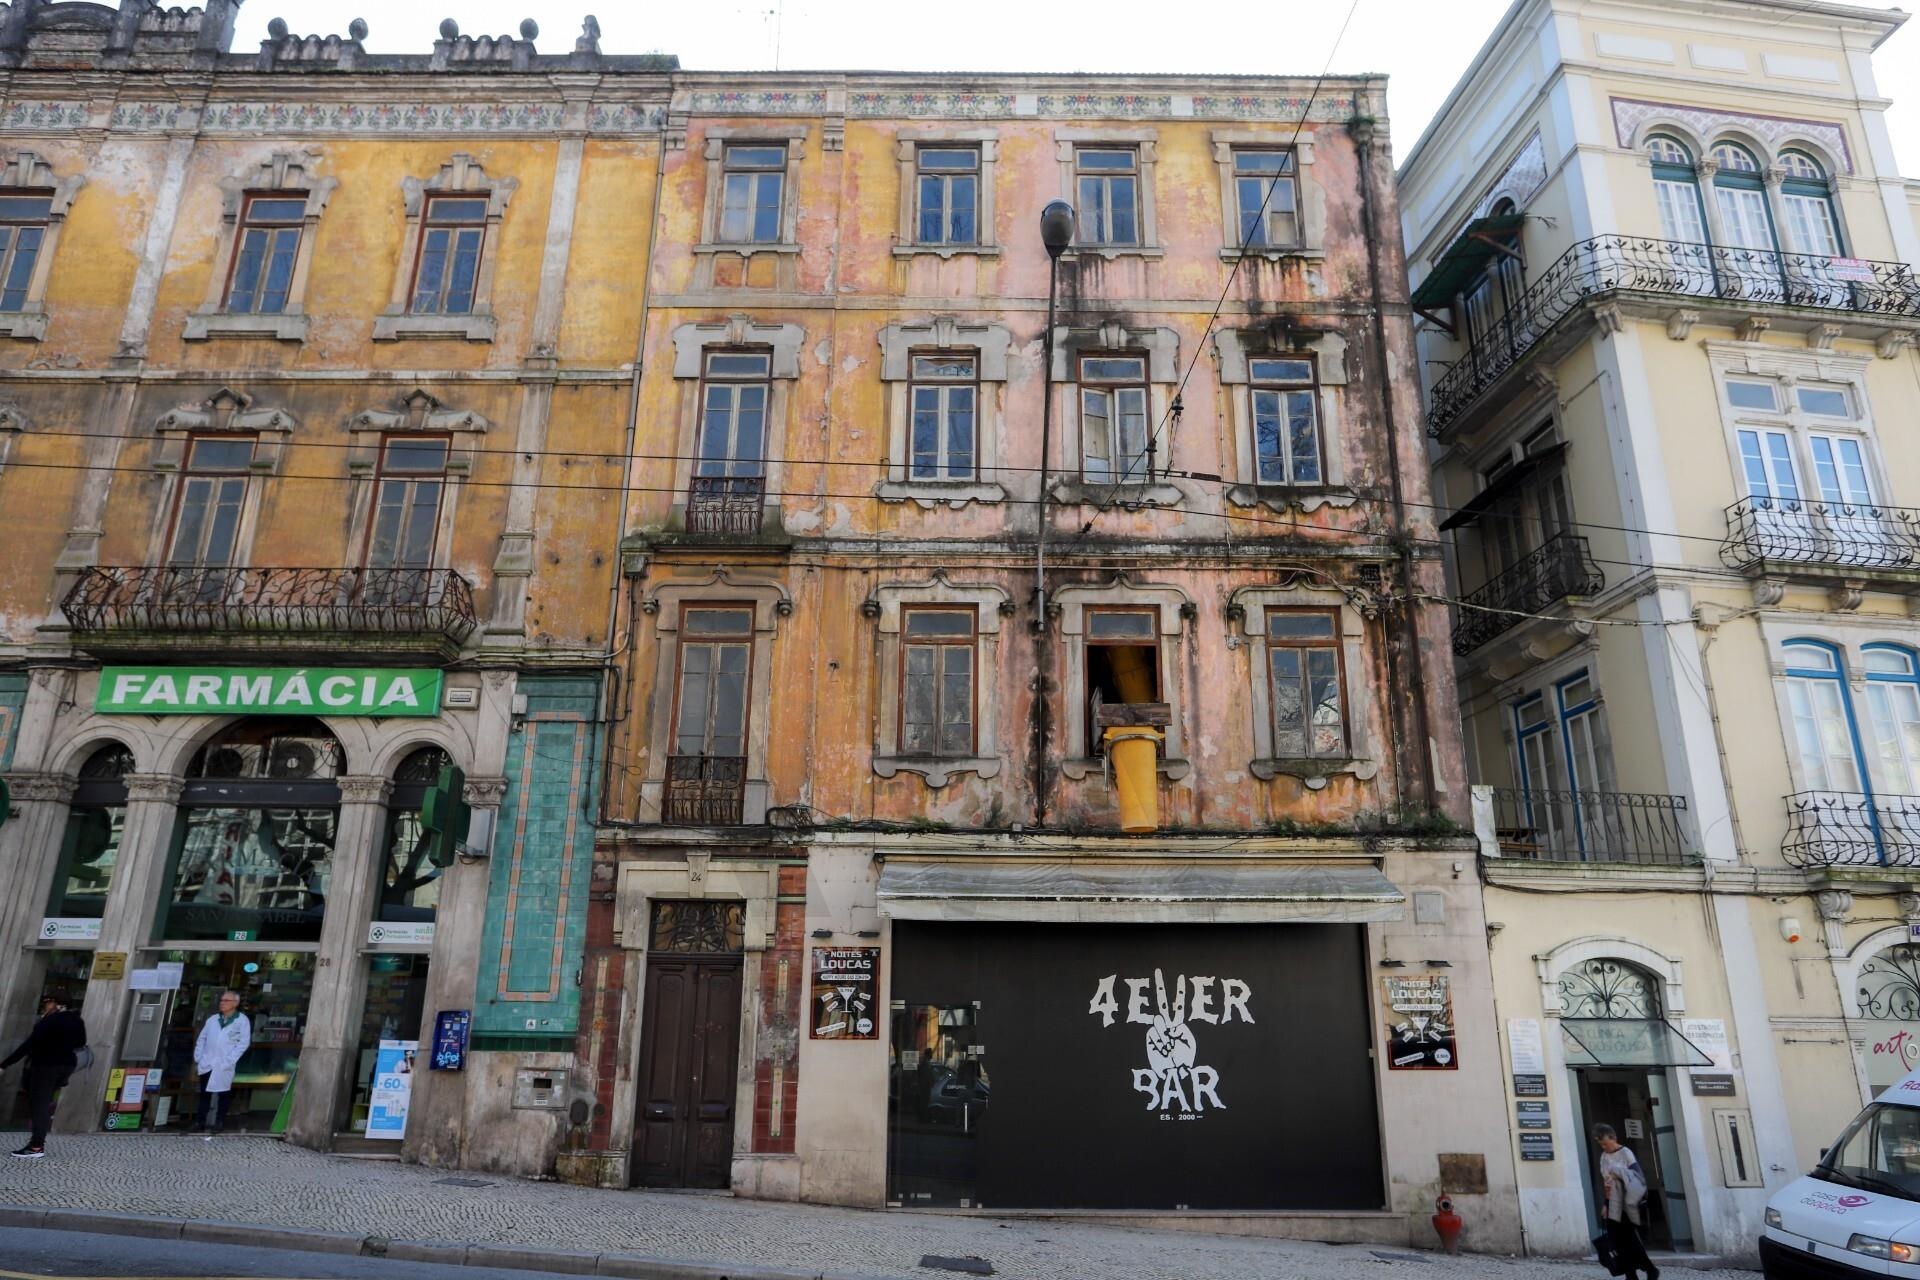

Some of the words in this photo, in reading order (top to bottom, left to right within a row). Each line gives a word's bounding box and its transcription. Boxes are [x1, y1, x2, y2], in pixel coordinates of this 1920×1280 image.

[111, 669, 419, 708] FARMÁCIA
[691, 871, 702, 883] 24
[234, 930, 248, 941] 28
[319, 957, 331, 967] 28
[820, 960, 872, 969] LOUCAS
[1089, 968, 1255, 1028] 4EVER
[1391, 989, 1442, 999] LOUCAS
[1131, 1065, 1227, 1112] BAR
